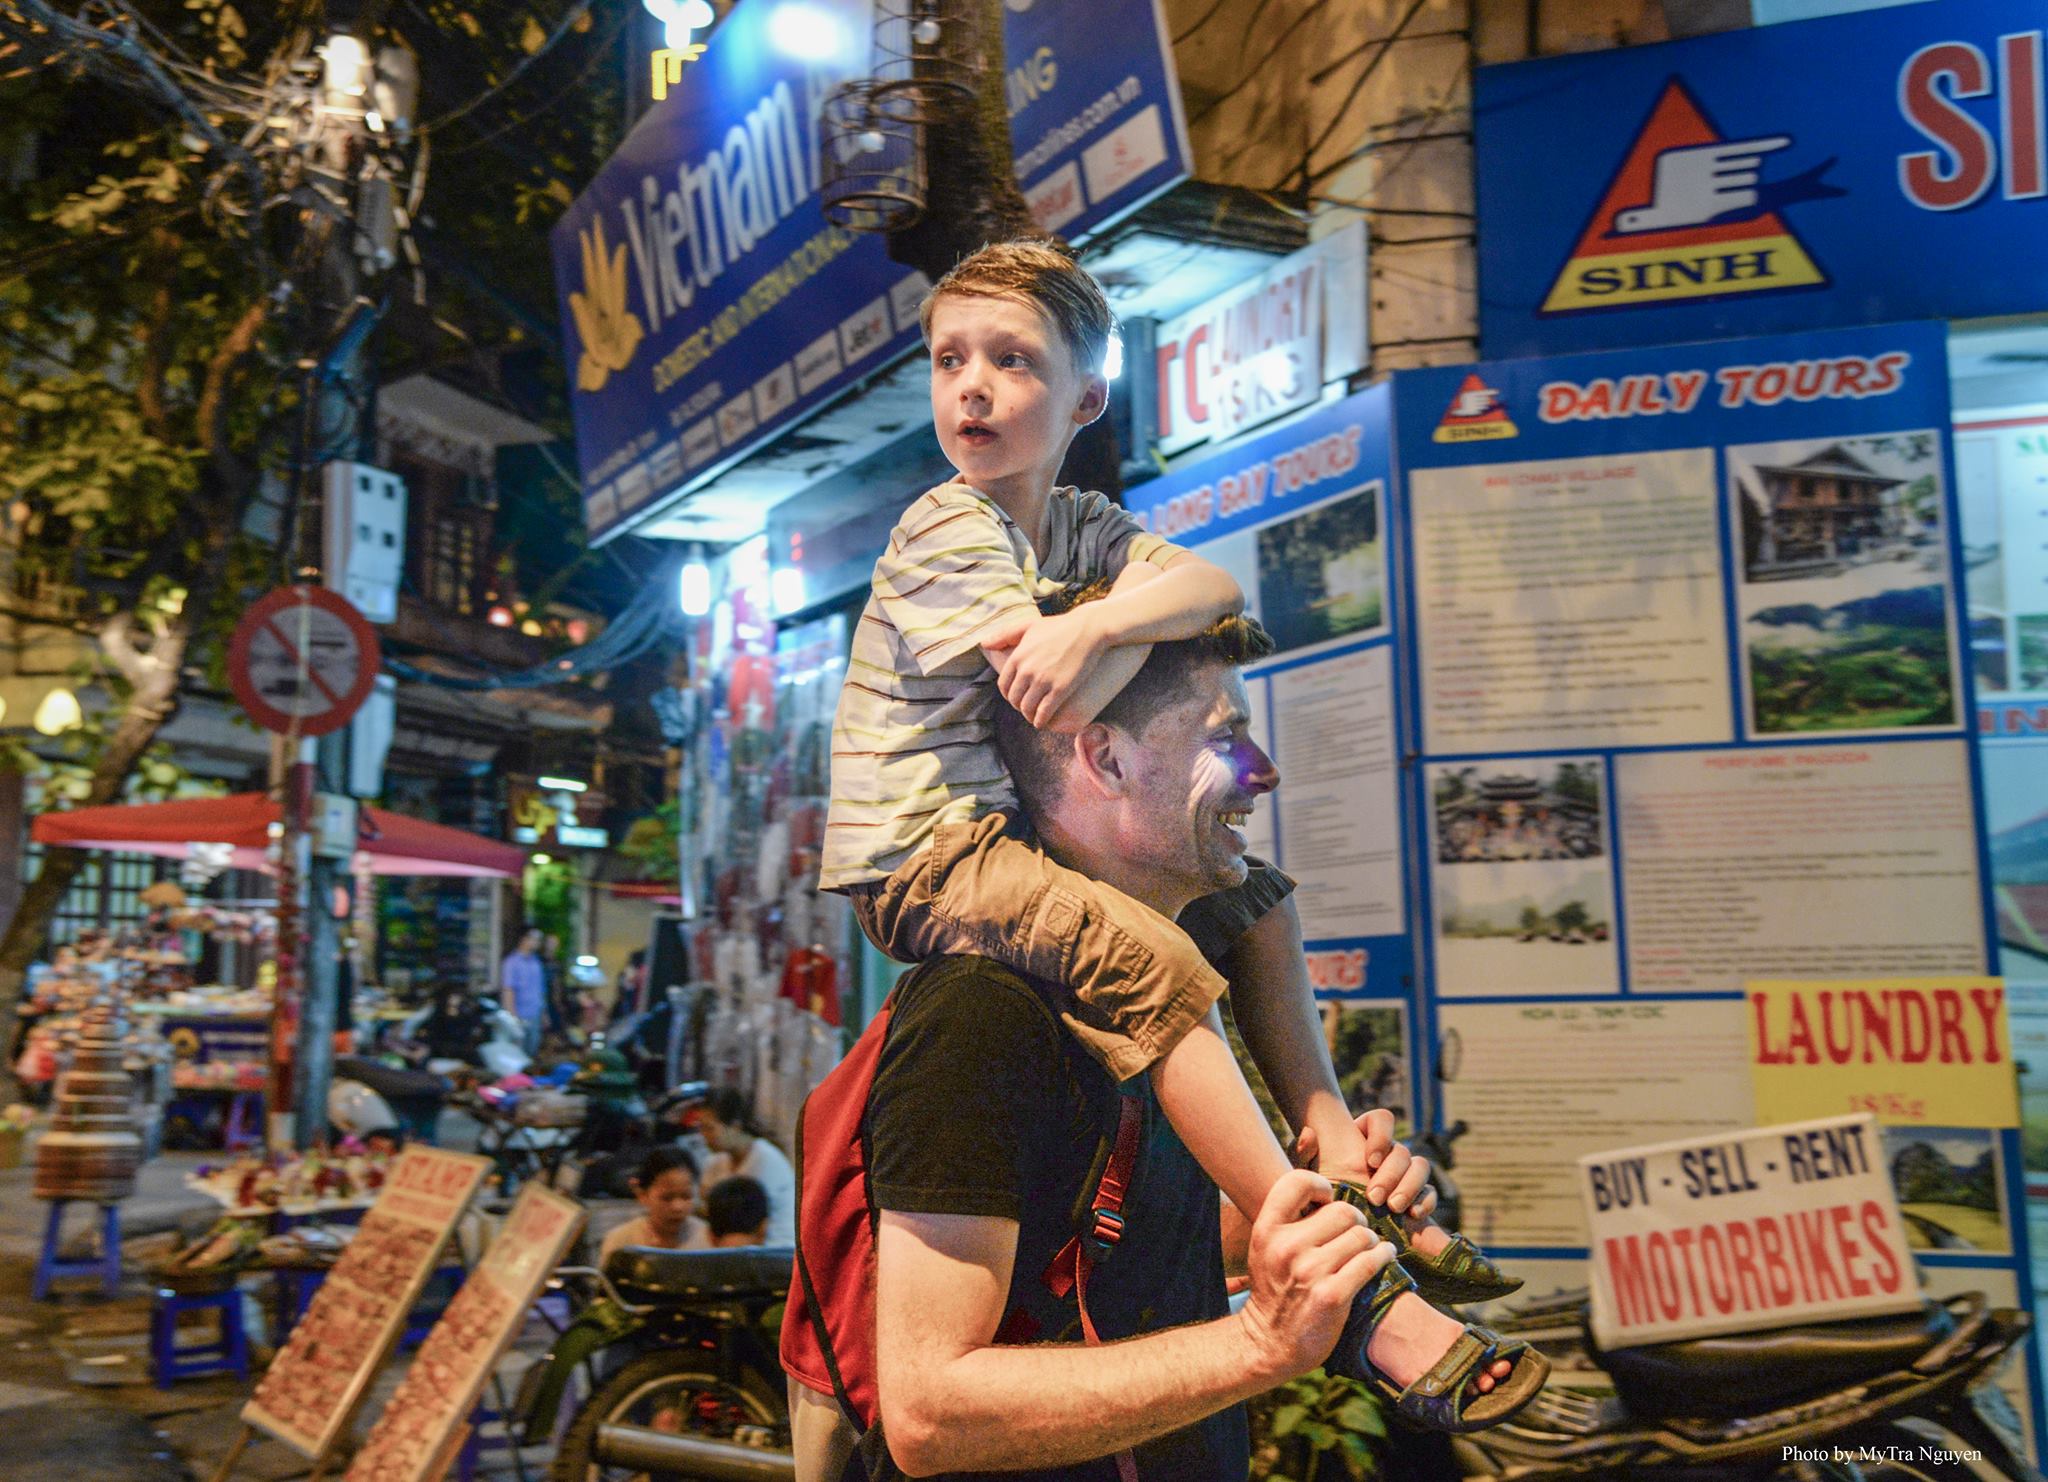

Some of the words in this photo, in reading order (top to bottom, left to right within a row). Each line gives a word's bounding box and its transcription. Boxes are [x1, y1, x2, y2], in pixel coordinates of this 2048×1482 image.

[621, 80, 809, 333] Vietnam
[1579, 249, 1778, 296] SINH
[1538, 371, 1706, 423] DAILY
[1716, 352, 1910, 408] TOURS
[1217, 462, 1270, 518] BAY
[1272, 425, 1364, 497] TOURS
[1752, 988, 2004, 1065] LAUNDRY
[1589, 1158, 1649, 1213] BUY
[1680, 1142, 1757, 1199] SELL
[1782, 1124, 1870, 1185] RENT
[1605, 1200, 1902, 1328] MOTORBIKES
